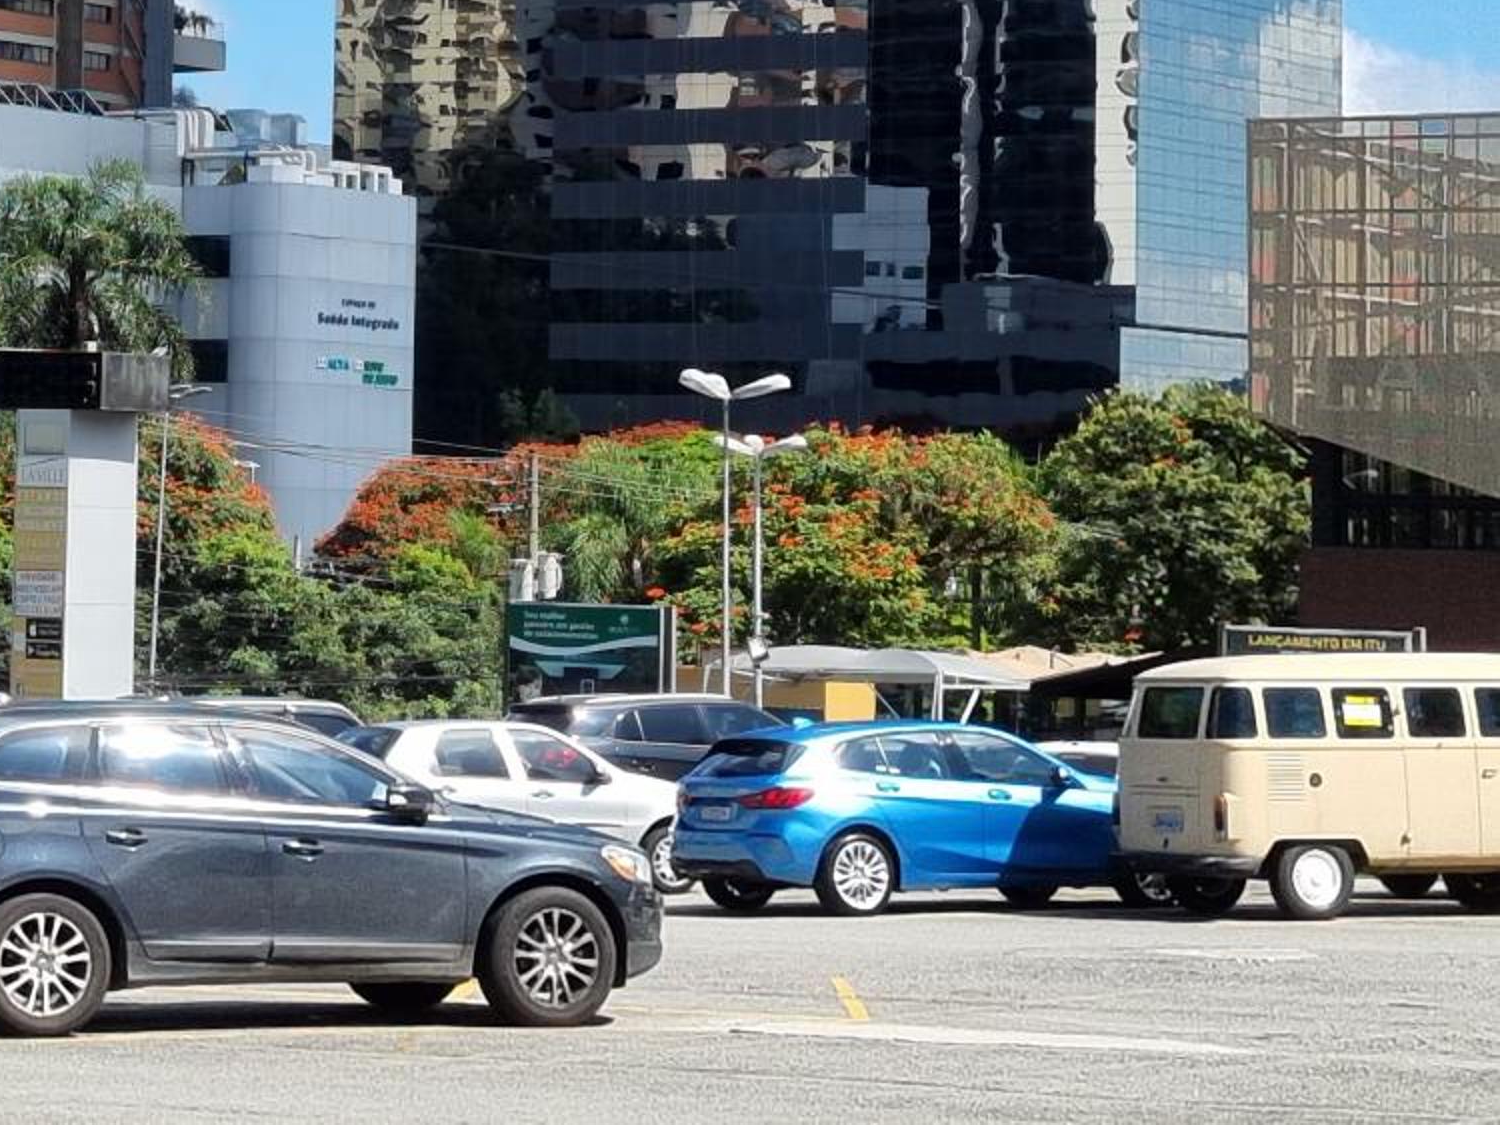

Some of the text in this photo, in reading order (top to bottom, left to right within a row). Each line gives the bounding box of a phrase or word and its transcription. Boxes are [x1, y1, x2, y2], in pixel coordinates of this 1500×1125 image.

[1248, 634, 1387, 652] LANÇAMENTO EM ITU
